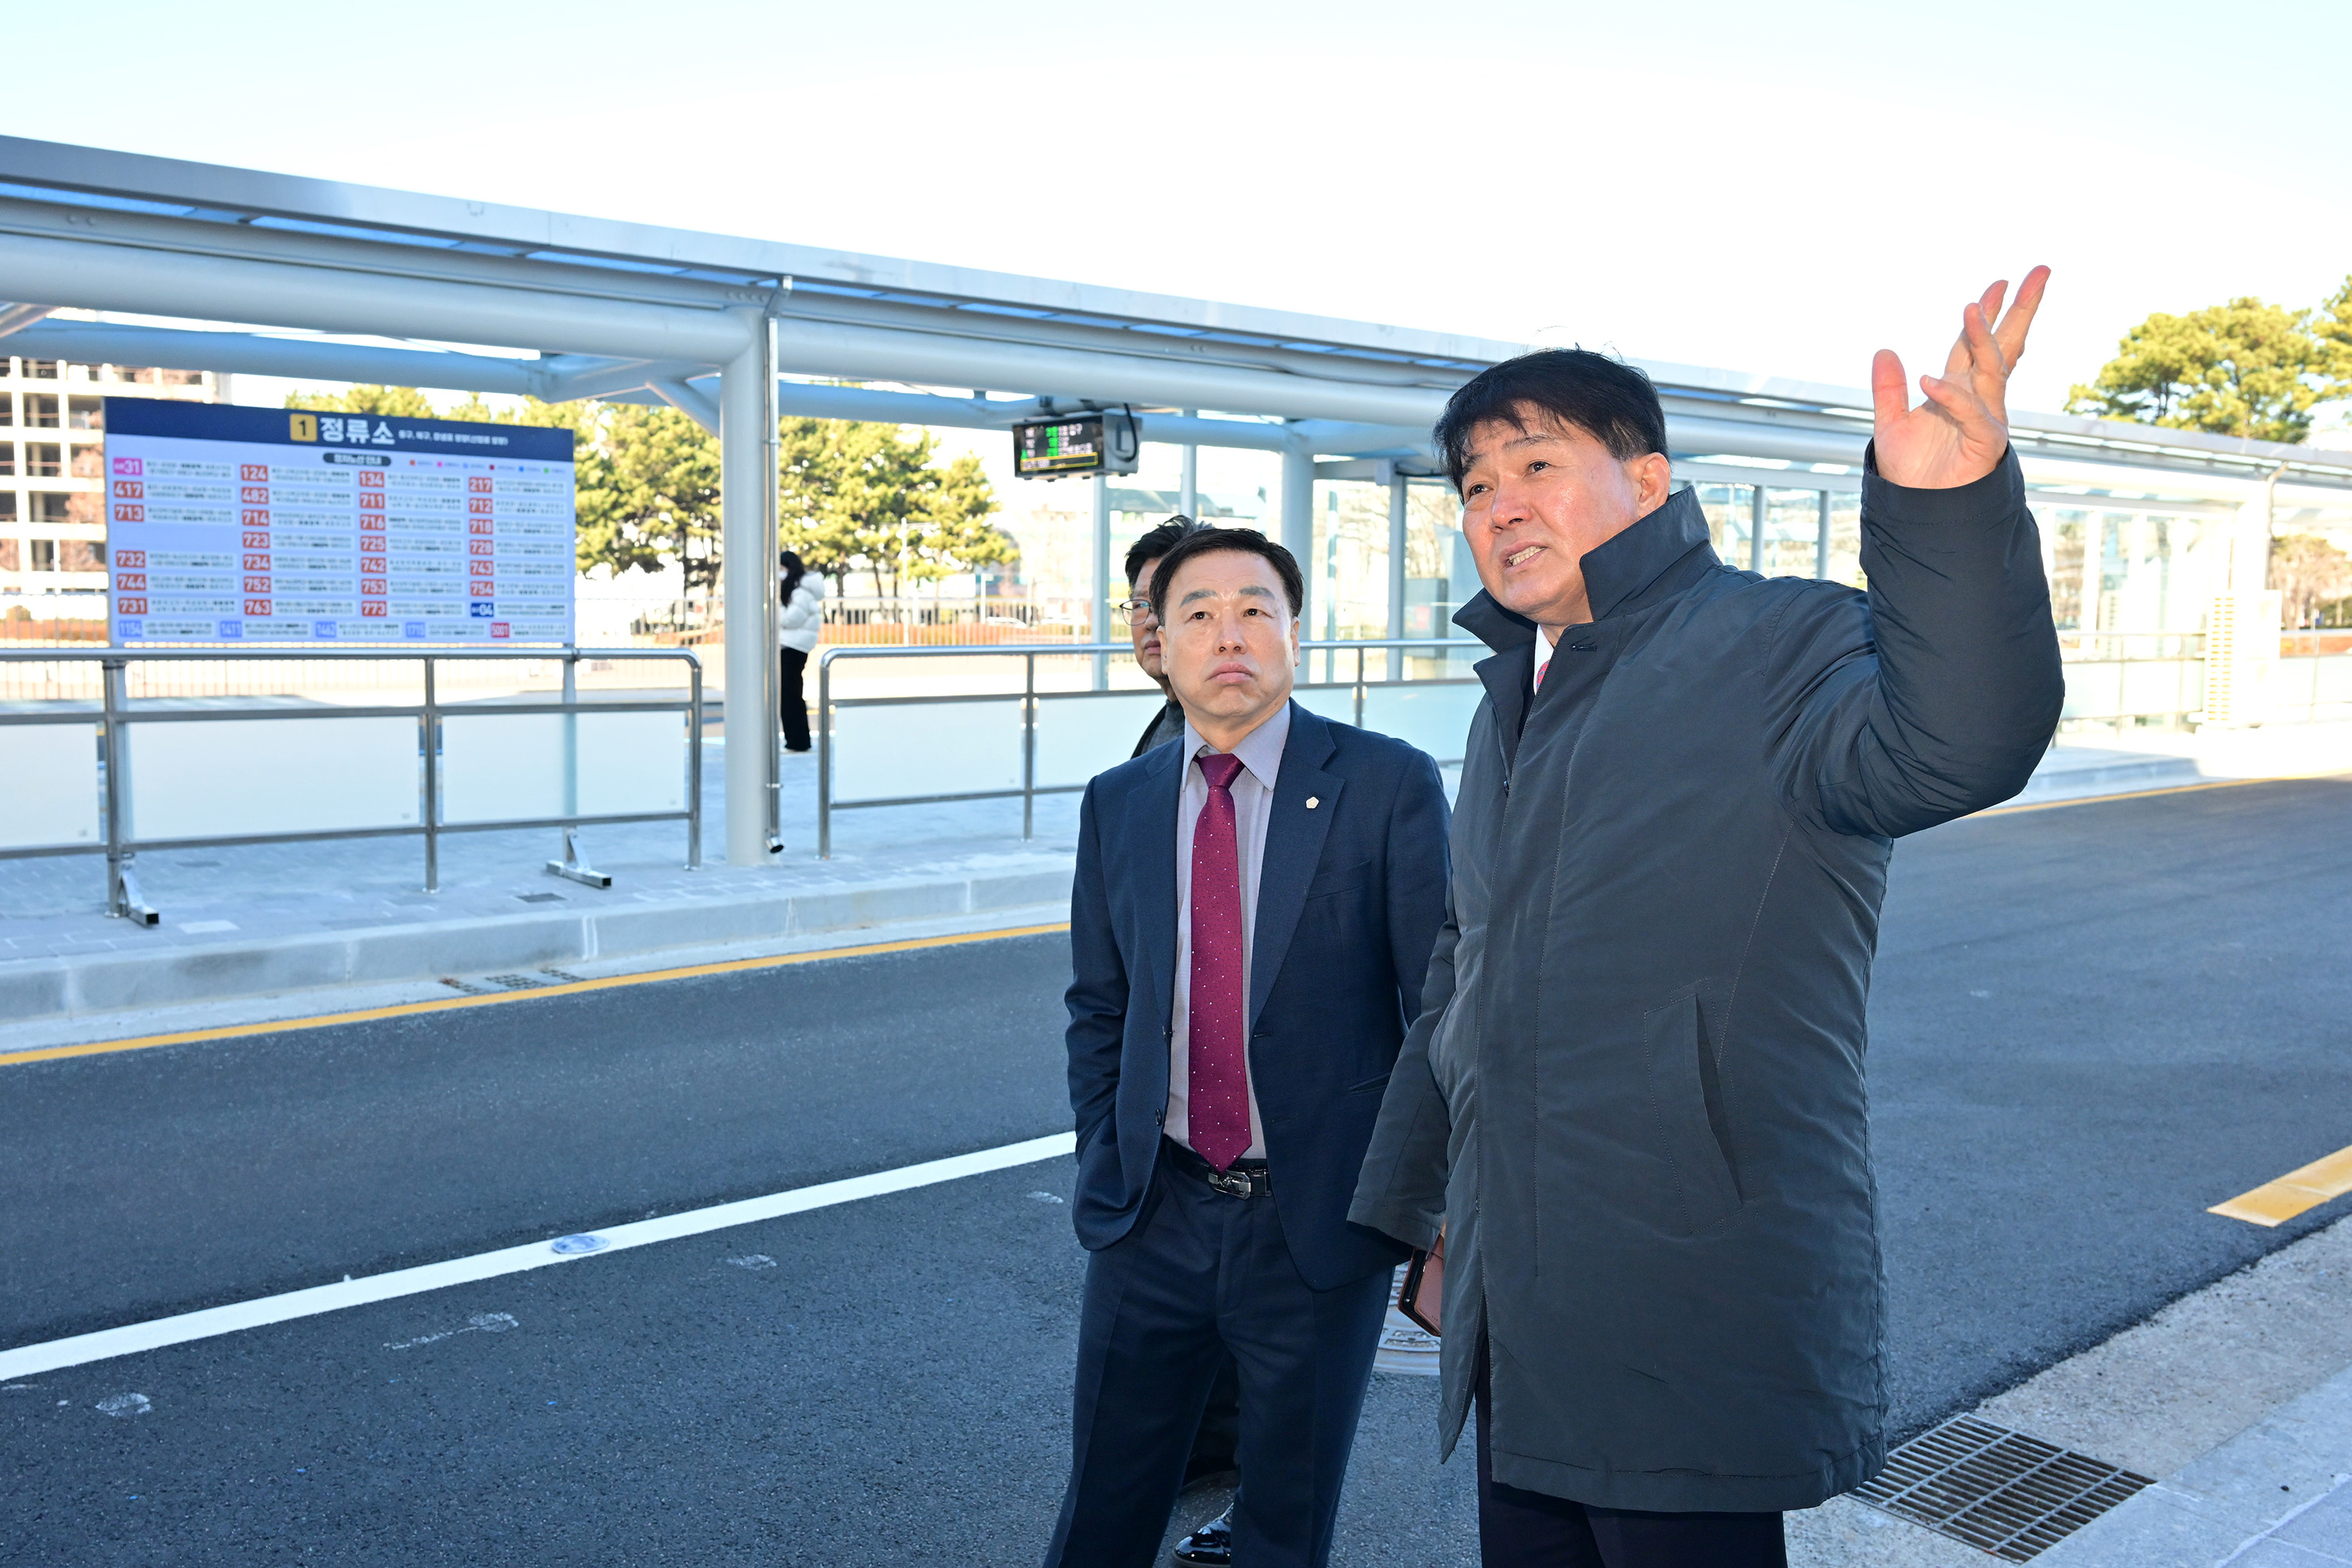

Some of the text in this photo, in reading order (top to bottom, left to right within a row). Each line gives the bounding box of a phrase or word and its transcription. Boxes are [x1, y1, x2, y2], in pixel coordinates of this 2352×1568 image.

[298, 417, 395, 445] 1 정류소
[241, 466, 267, 480] 124
[359, 474, 383, 485] 134
[114, 484, 142, 497] 417
[470, 479, 492, 491] 217
[360, 495, 383, 506] 711
[470, 499, 492, 512] 712
[115, 506, 143, 520] 713
[118, 599, 146, 612] 731
